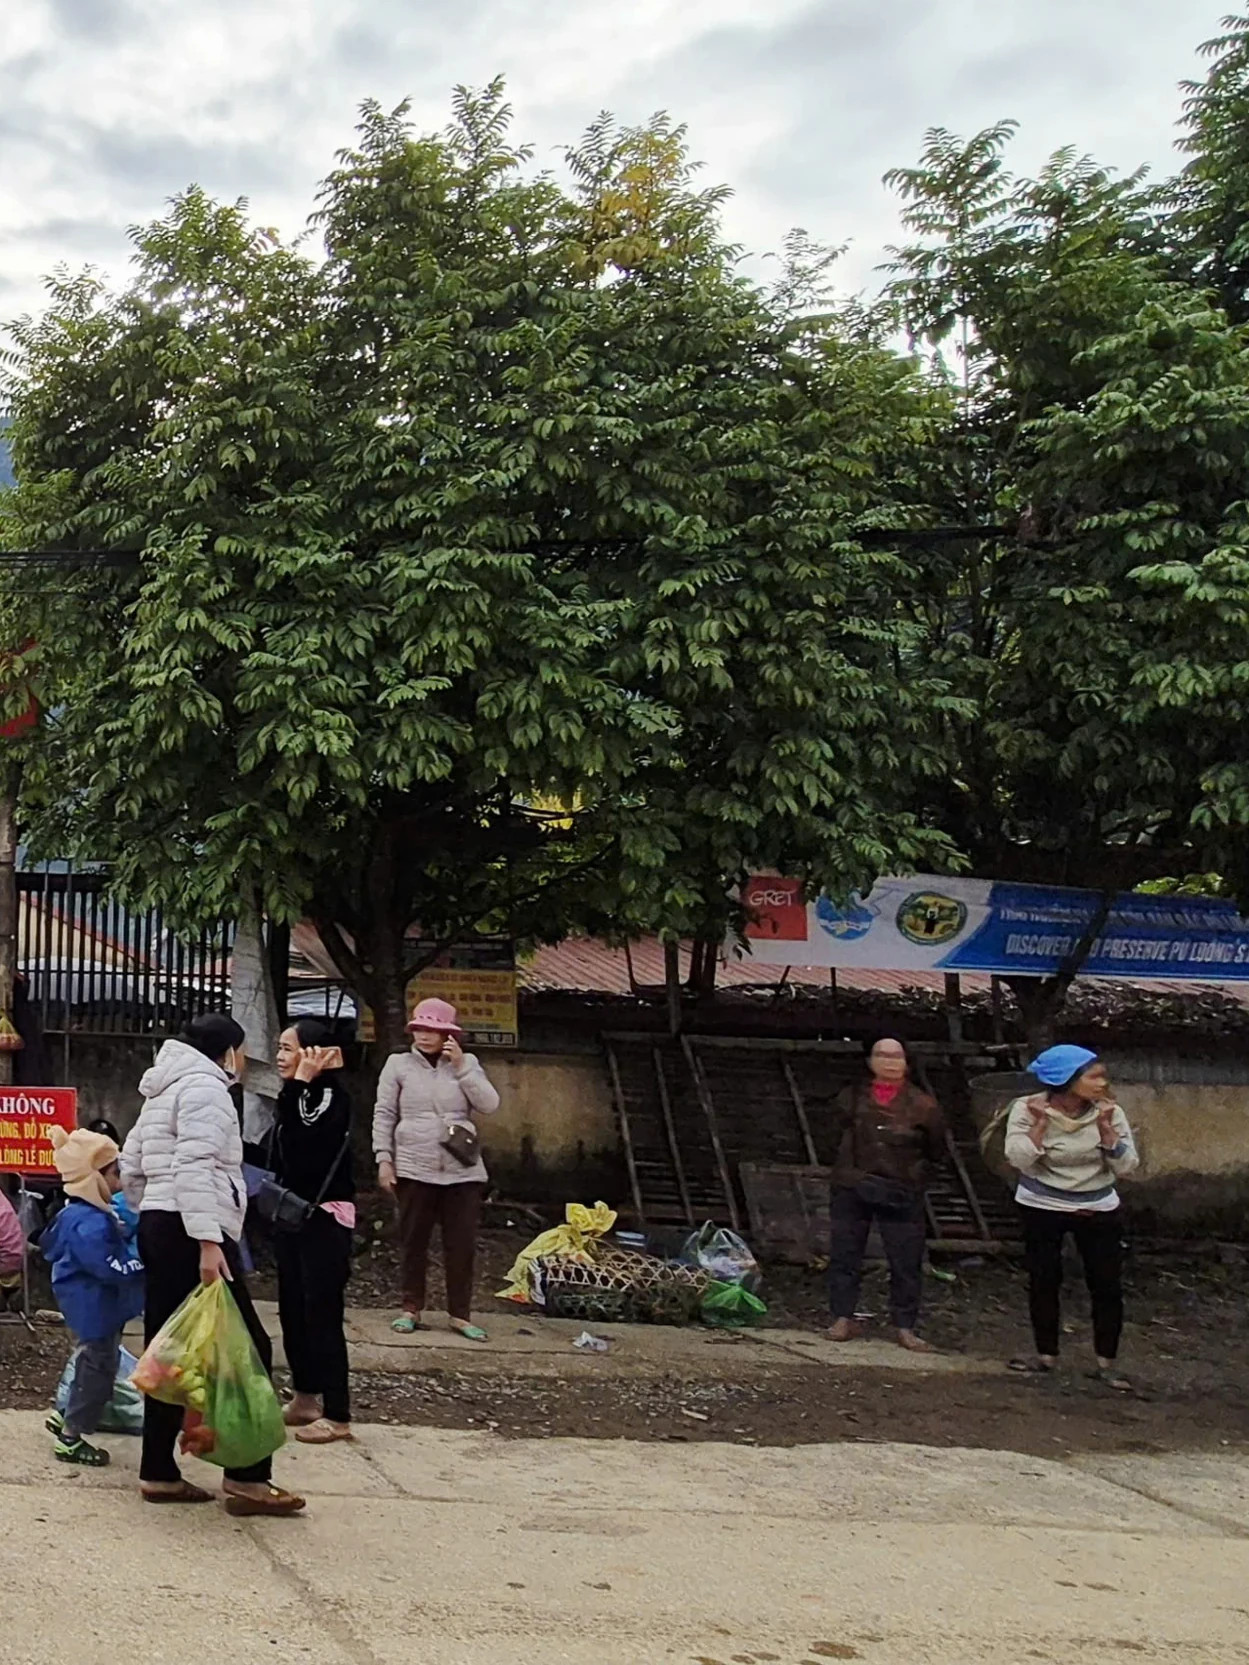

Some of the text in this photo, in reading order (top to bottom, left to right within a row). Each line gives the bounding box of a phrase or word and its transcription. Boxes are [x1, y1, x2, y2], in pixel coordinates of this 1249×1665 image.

[748, 888, 797, 907] GRET
[1005, 933, 1072, 957] DISCOVER
[1100, 938, 1171, 960] PRESERVE
